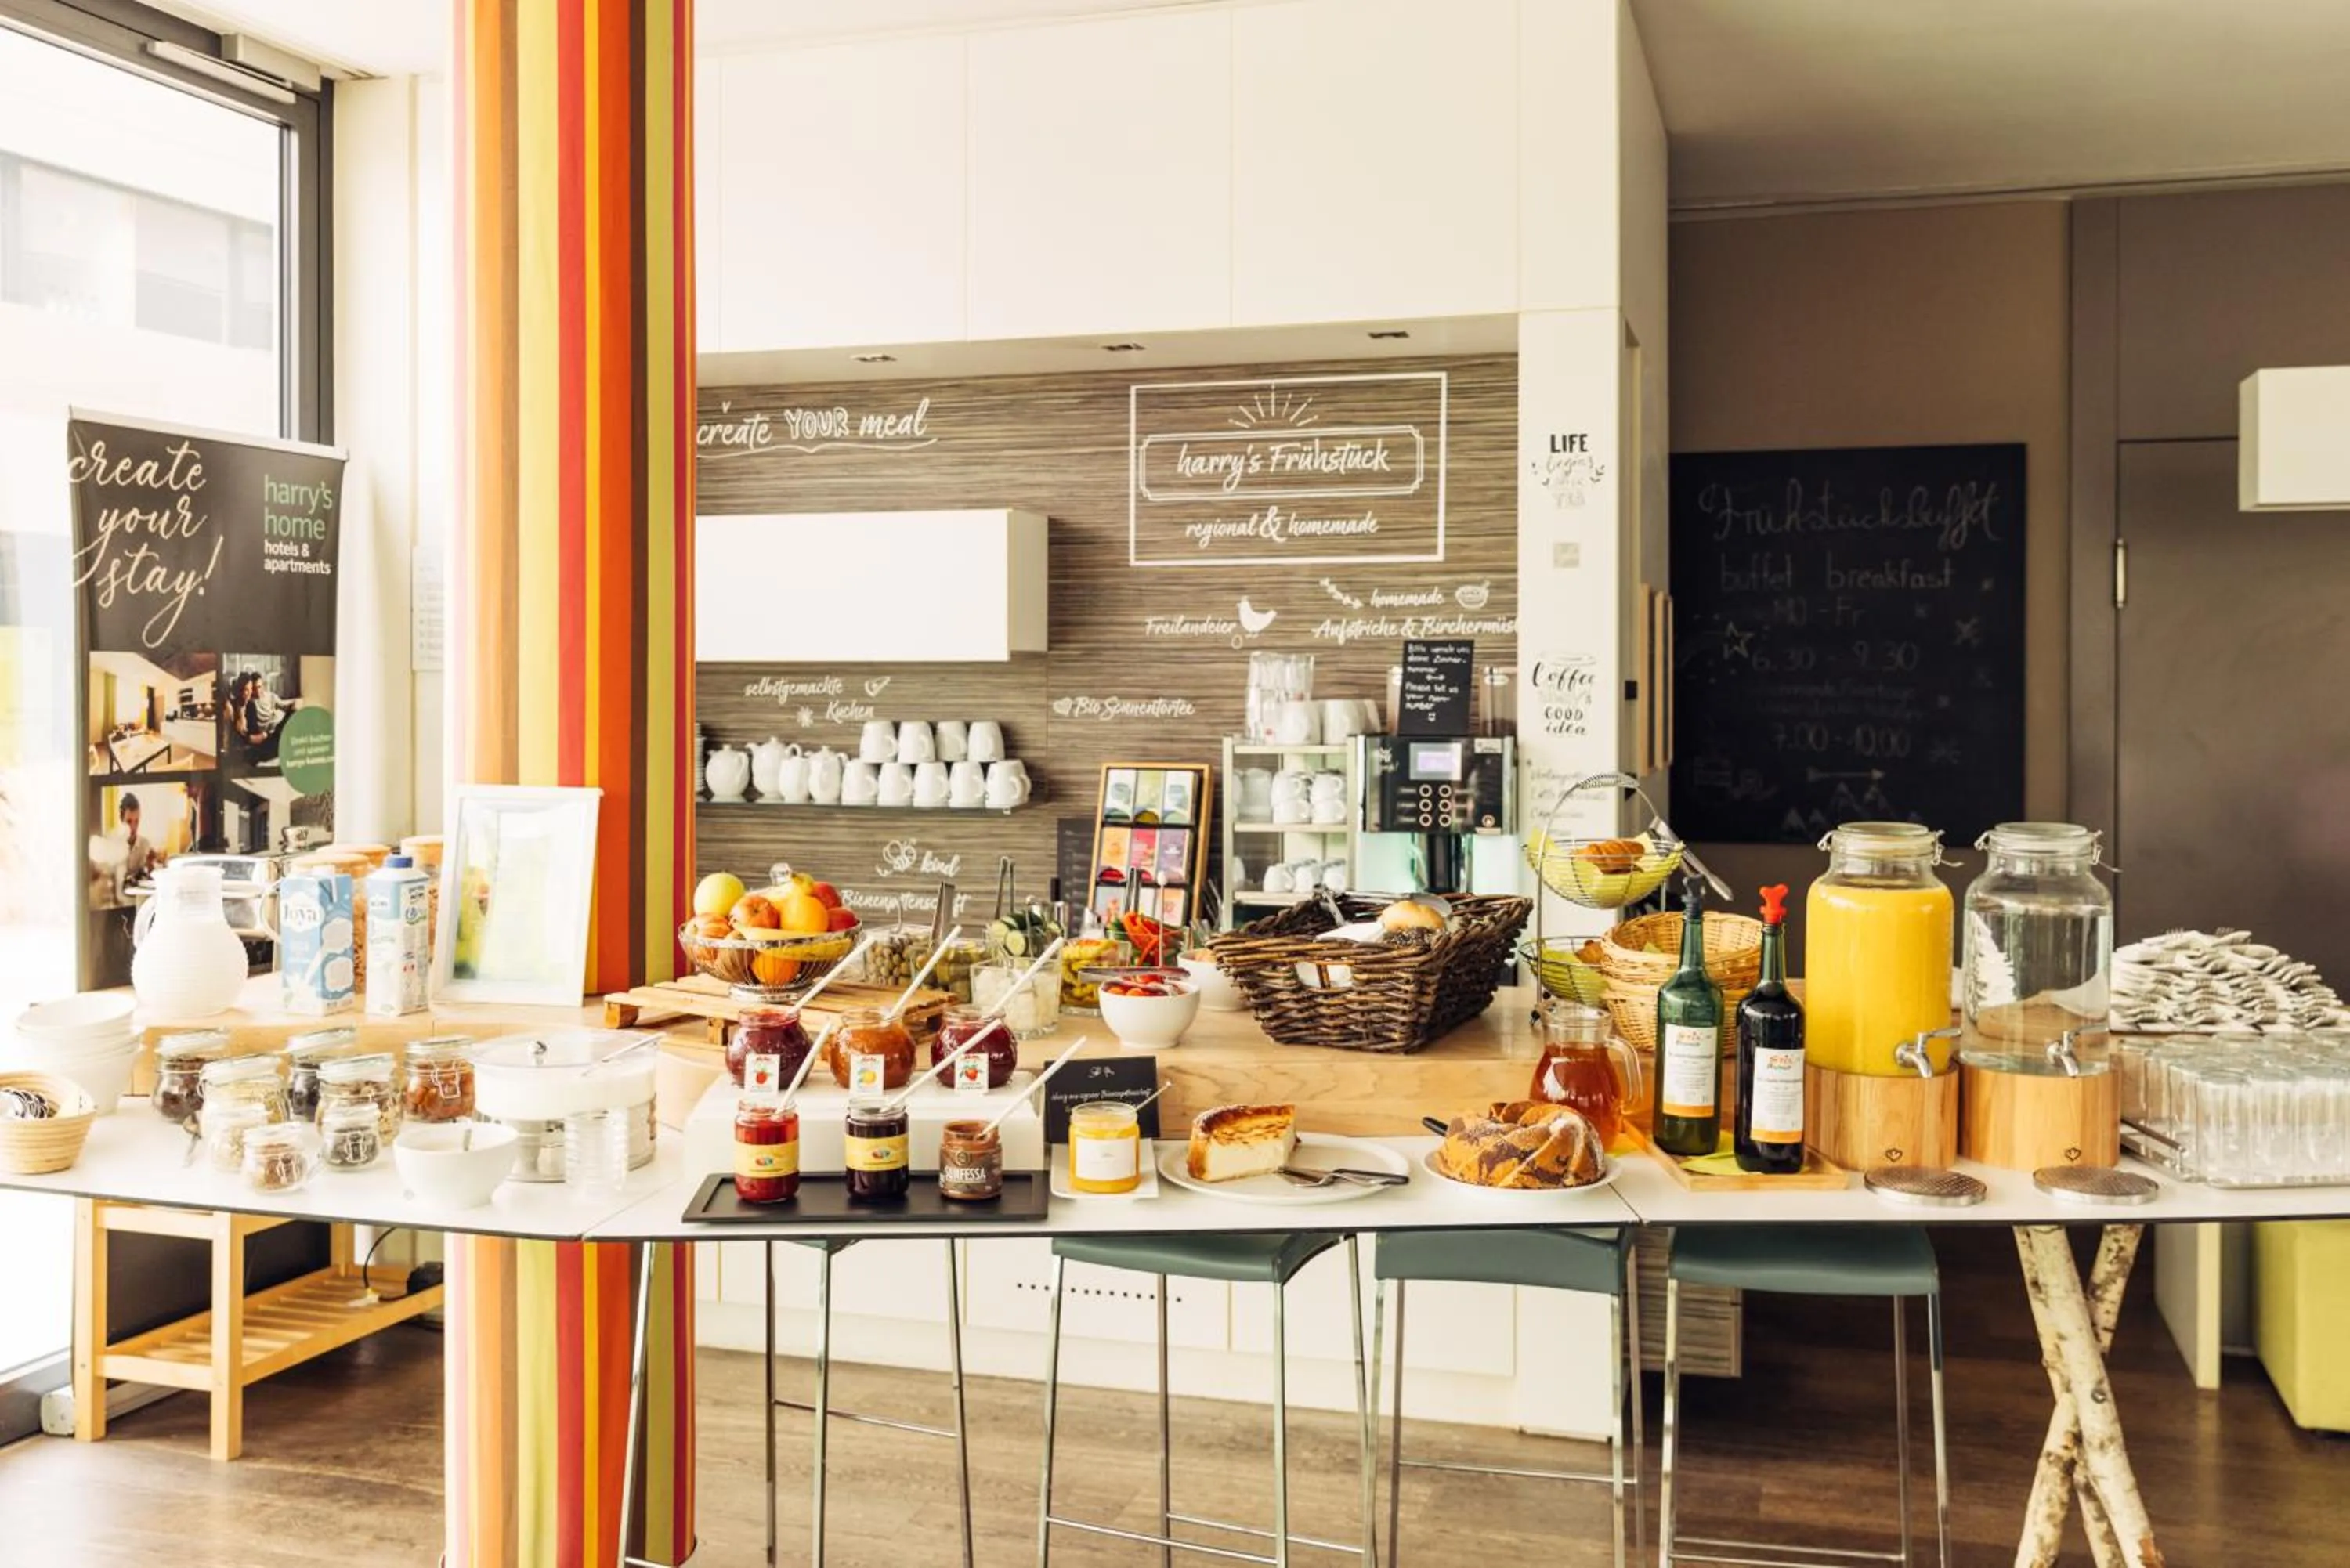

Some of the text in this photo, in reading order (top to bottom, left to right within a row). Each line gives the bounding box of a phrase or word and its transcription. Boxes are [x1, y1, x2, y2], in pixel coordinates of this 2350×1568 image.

[696, 397, 931, 450] create YOUR meal
[1550, 434, 1589, 453] LIFE
[67, 439, 207, 492] create
[1177, 438, 1391, 492] harry's Frühstück
[264, 474, 333, 514] harry's
[264, 508, 326, 540] home
[1185, 506, 1379, 548] regional & homemade
[72, 494, 208, 587] your
[264, 539, 310, 556] hotels &
[264, 558, 331, 576] apartments
[1825, 551, 1957, 591] breakfast
[1371, 586, 1444, 607] homemade
[1145, 615, 1237, 637] Freilandeier
[1311, 616, 1398, 645] Aufstriche
[745, 676, 844, 704] selbstgemachte
[1532, 661, 1596, 691] Coffee
[826, 700, 874, 724] Kuchen
[1074, 696, 1100, 717] Bio
[1545, 706, 1584, 721] GOOD
[1546, 721, 1586, 735] idea
[920, 851, 960, 877] kind
